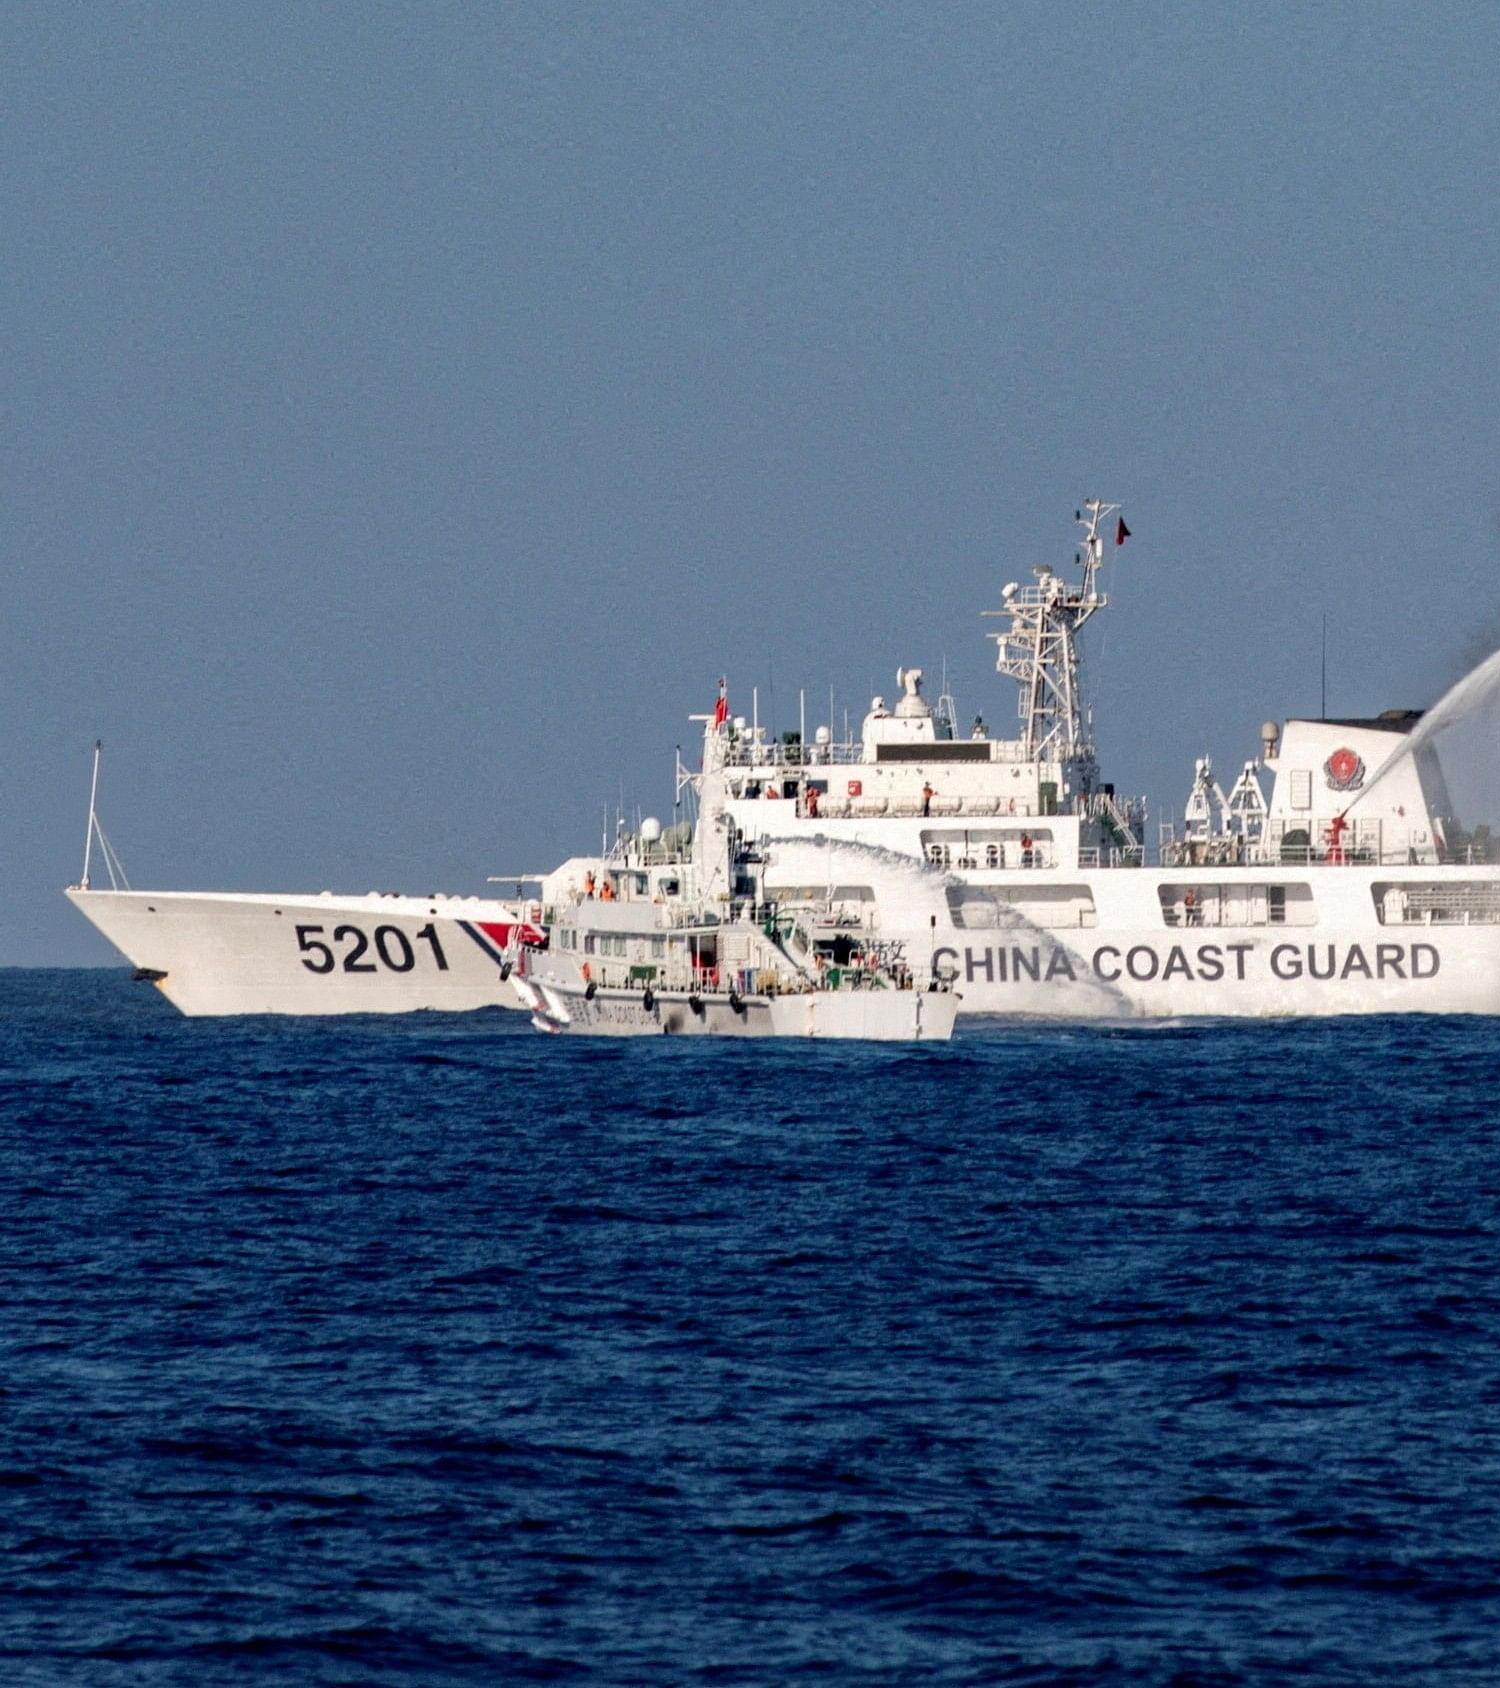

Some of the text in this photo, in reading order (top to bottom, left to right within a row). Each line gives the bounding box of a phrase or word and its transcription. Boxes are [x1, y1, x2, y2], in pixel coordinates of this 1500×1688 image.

[295, 923, 449, 974] 5201
[931, 946, 1077, 983] CHINA
[1092, 944, 1254, 981] COAST
[1270, 943, 1441, 980] GUARD
